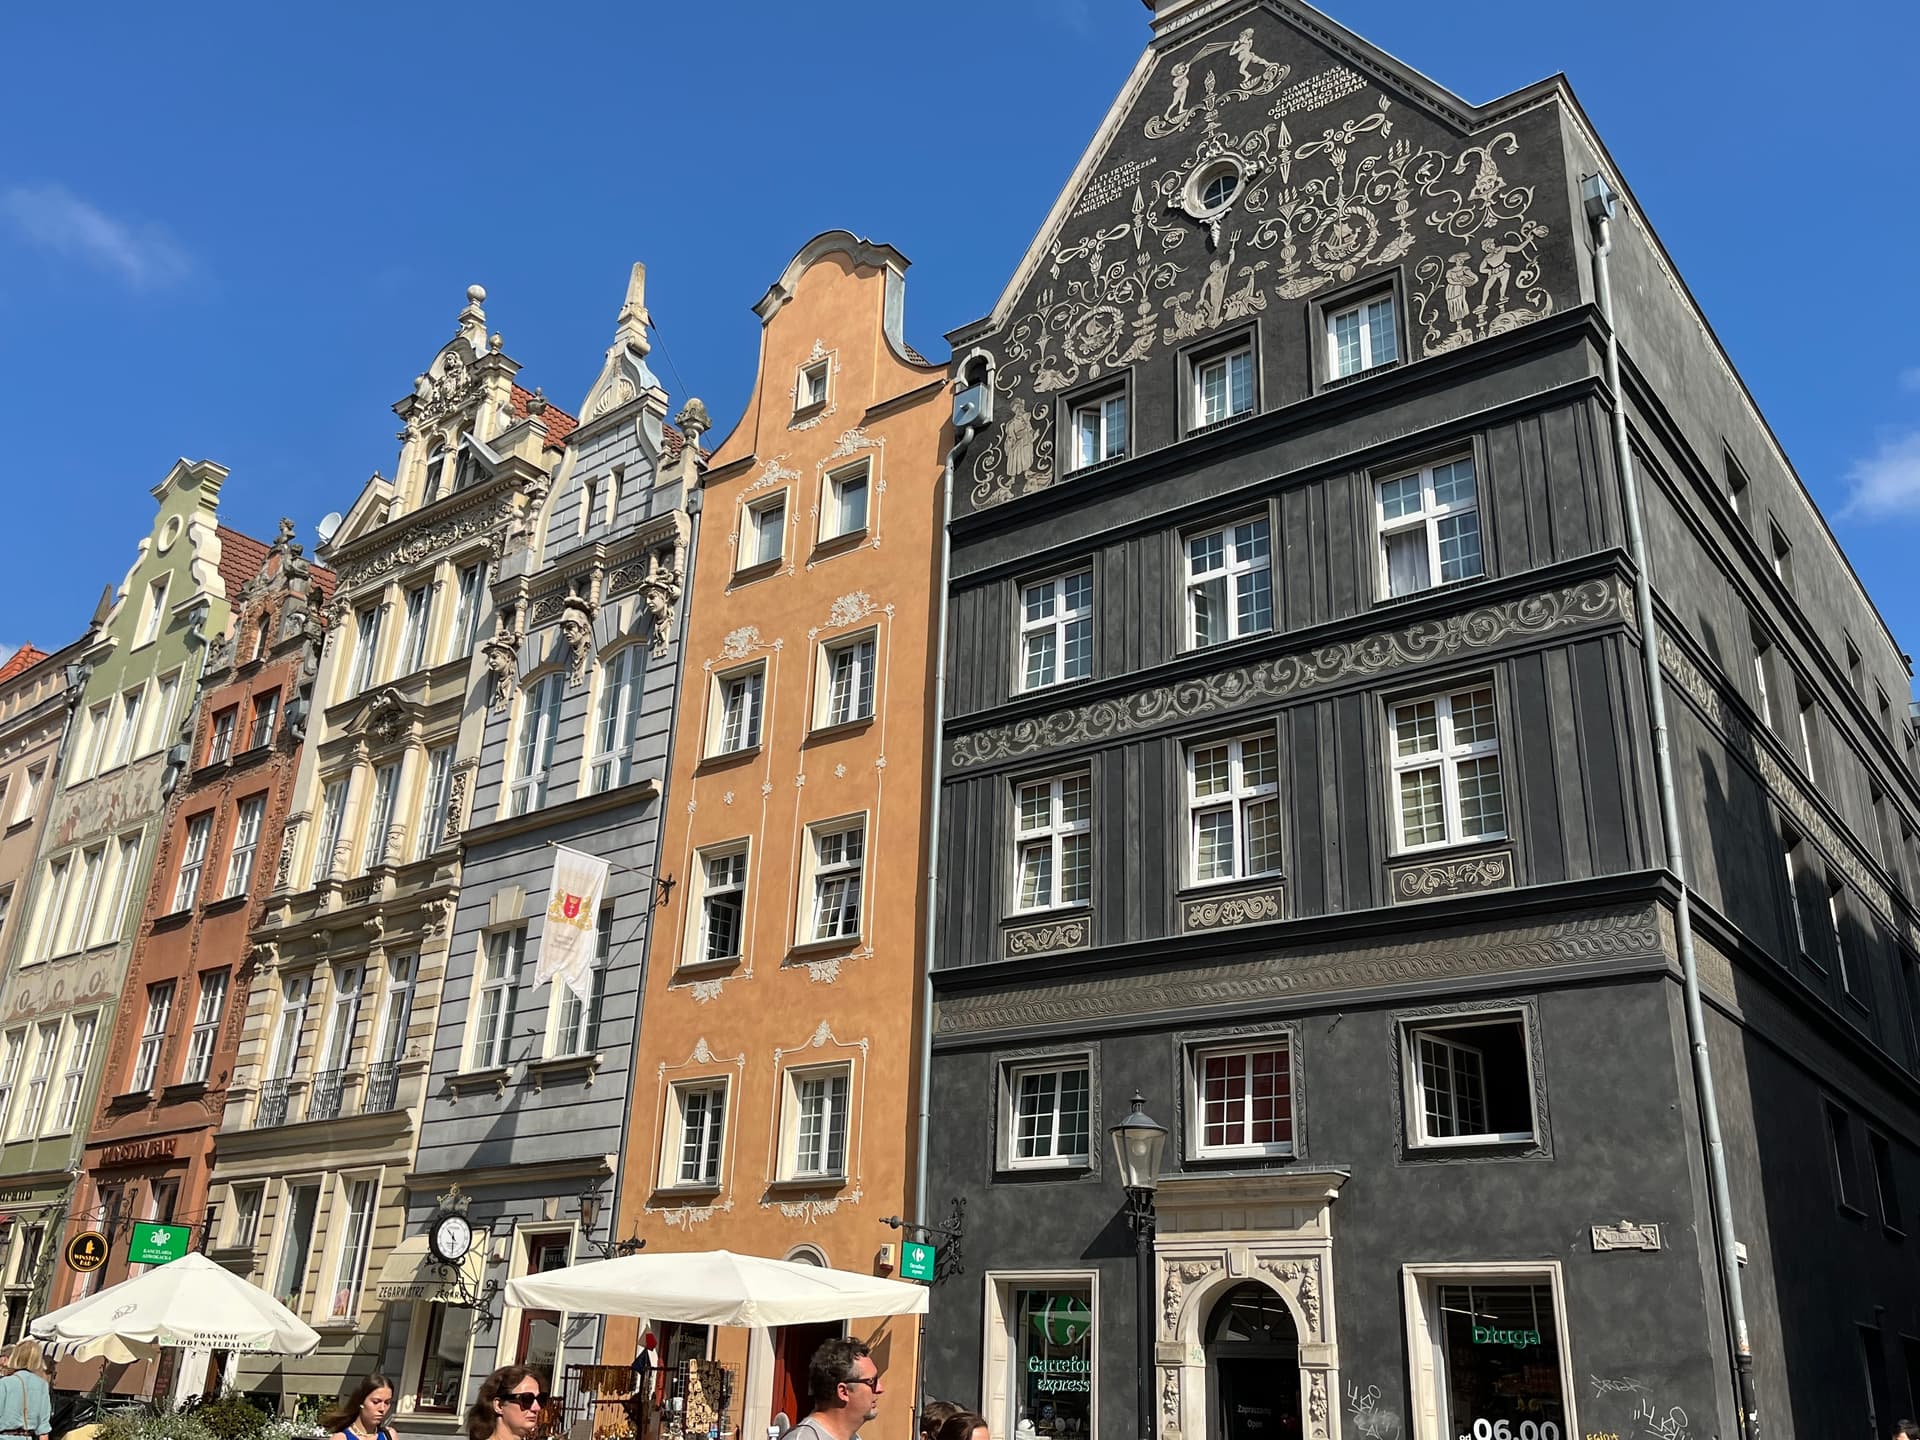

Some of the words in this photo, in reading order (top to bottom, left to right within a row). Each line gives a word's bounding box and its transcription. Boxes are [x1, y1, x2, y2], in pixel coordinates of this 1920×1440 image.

[1323, 64, 1342, 78] NAS
[1274, 111, 1288, 120] OD
[1088, 184, 1101, 193] NIE
[1108, 174, 1121, 184] CO
[1122, 156, 1158, 177] MORZEM
[1100, 172, 1109, 182] TY
[1111, 186, 1122, 196] NA
[1124, 178, 1141, 189] NAS
[74, 1253, 100, 1263] WINSTON
[378, 1286, 425, 1298] ZEGARMISTRZ
[175, 1338, 198, 1346] LODY
[200, 1340, 254, 1349] NATURALNE
[1472, 1325, 1541, 1349] Długa
[1037, 1378, 1090, 1394] express
[1473, 1418, 1560, 1440] 06.00
